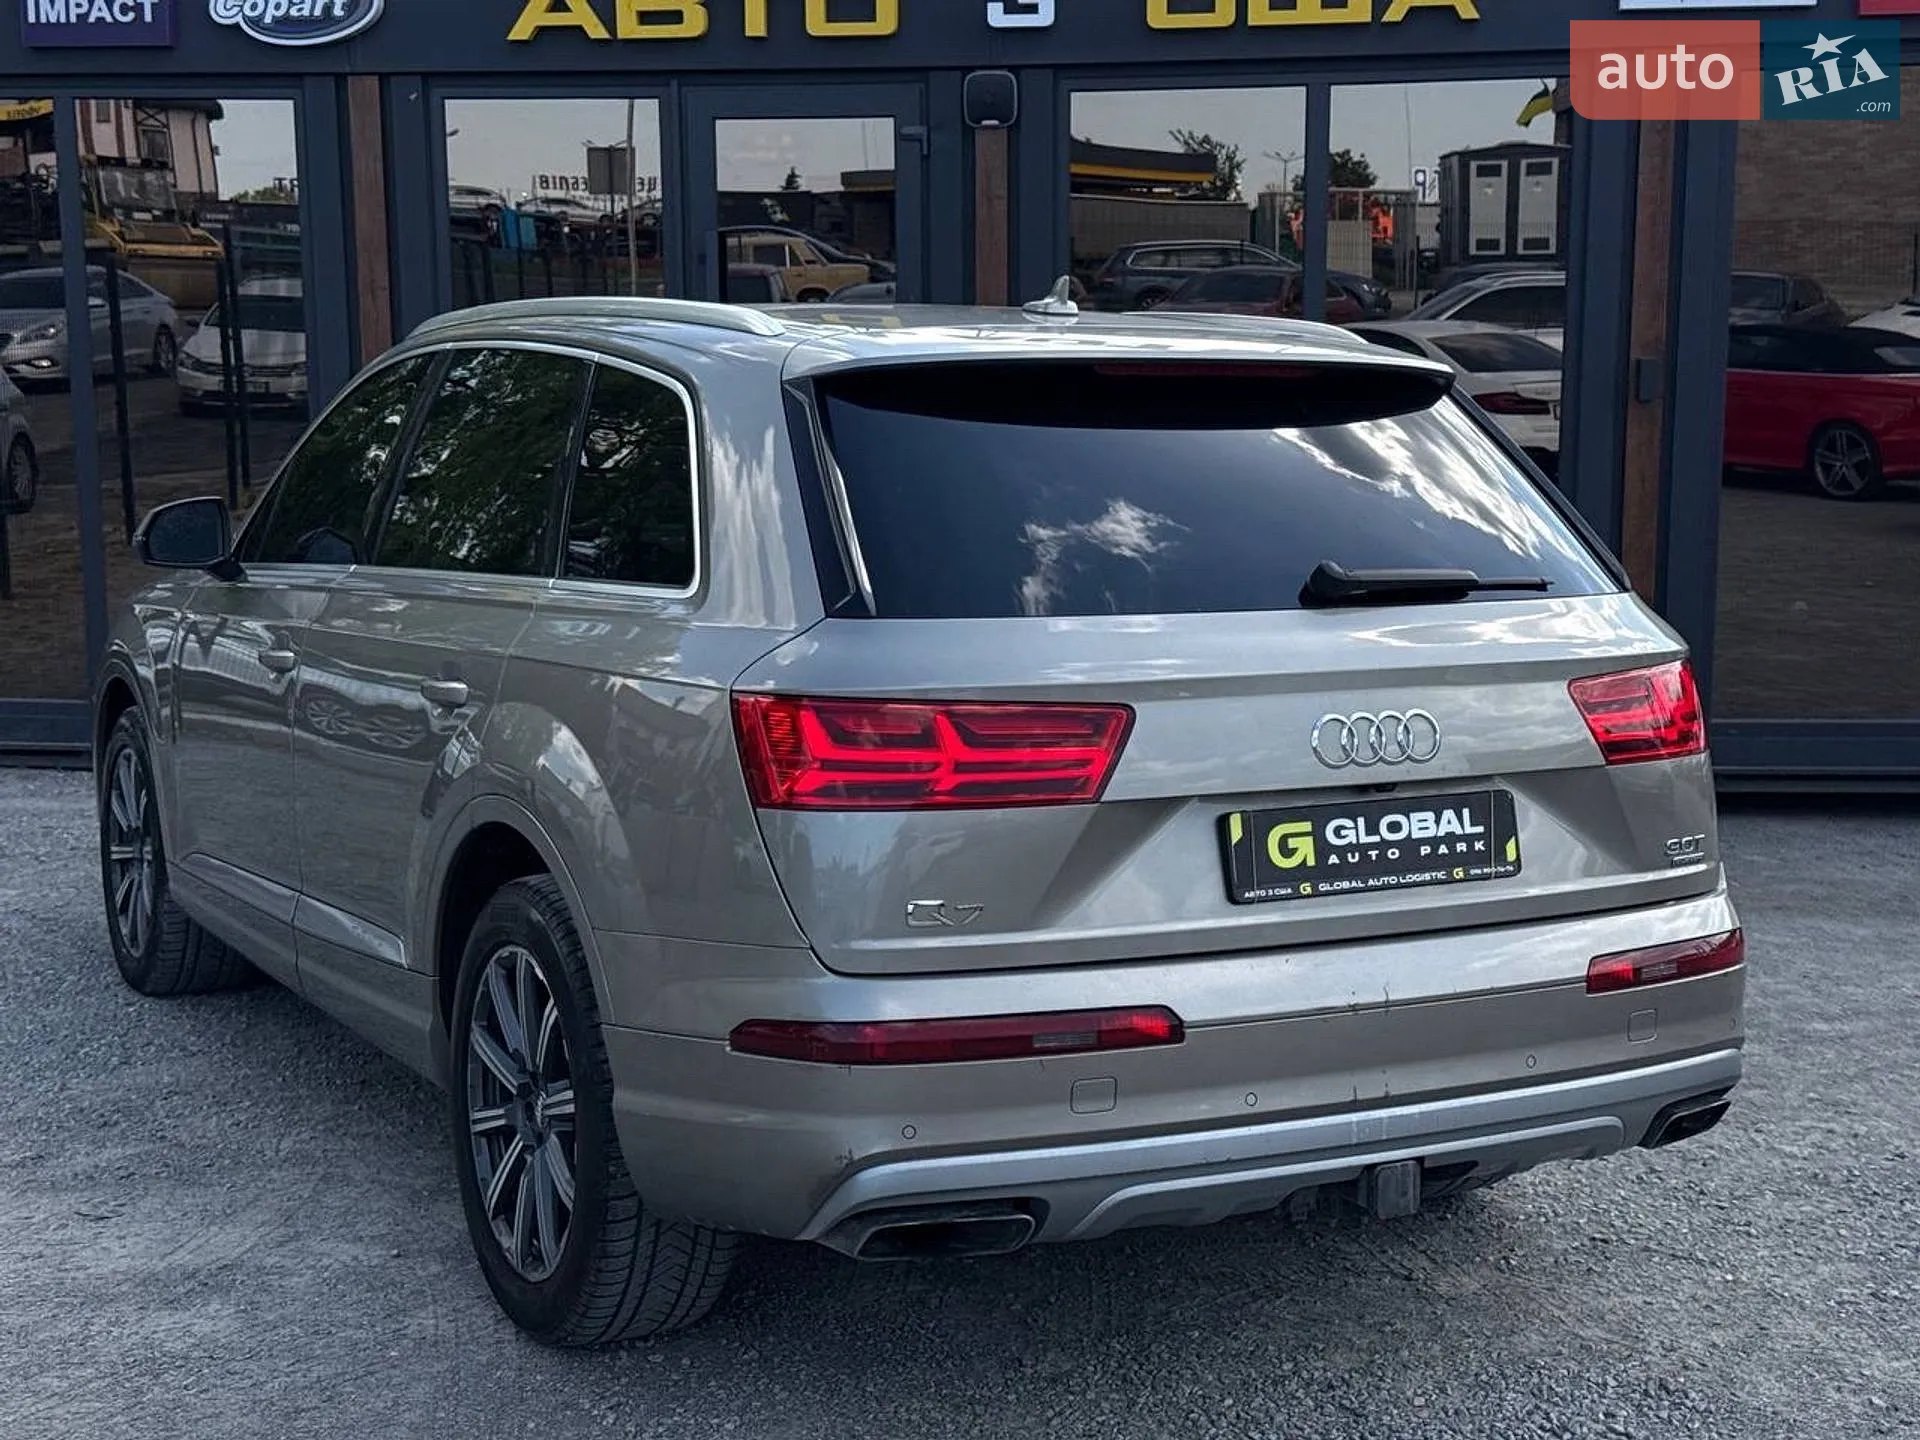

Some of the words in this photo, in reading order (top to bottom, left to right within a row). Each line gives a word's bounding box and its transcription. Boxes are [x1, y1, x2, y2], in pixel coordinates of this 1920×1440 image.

[27, 0, 158, 23] IMPACT
[215, 0, 348, 24] Copart
[1325, 808, 1485, 846] GLOBAL
[1328, 848, 1400, 865] AUTO
[1420, 840, 1486, 856] PARK
[1318, 878, 1366, 892] GLOBAL
[1366, 875, 1398, 887] AUTO
[1399, 870, 1448, 884] LOGISTIC
[906, 900, 984, 928] Q7
